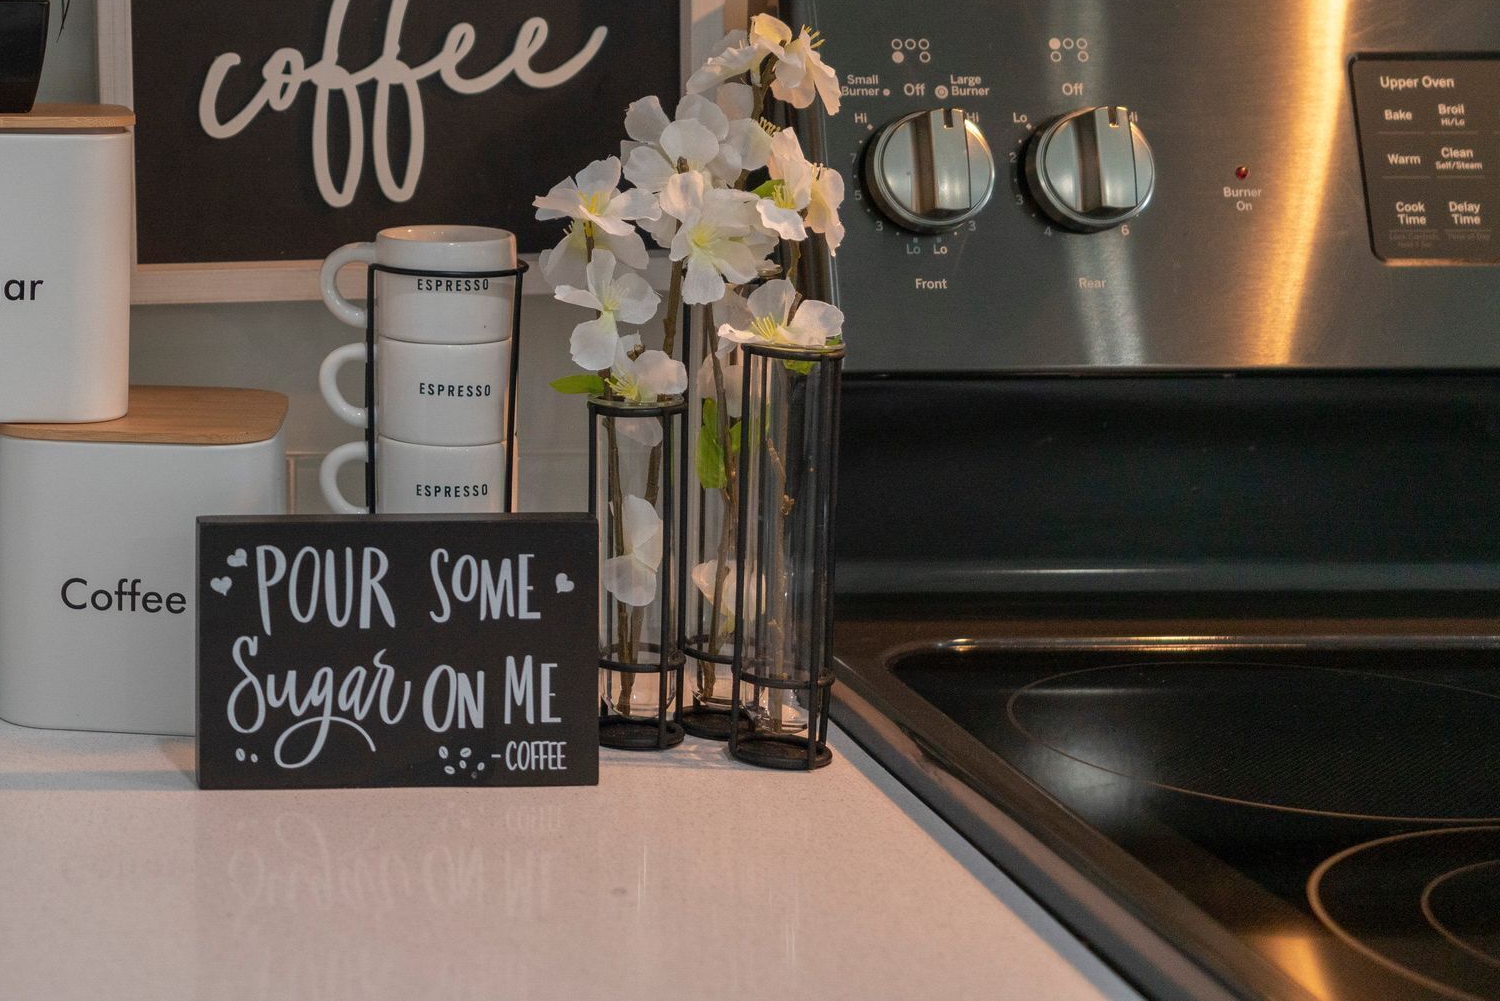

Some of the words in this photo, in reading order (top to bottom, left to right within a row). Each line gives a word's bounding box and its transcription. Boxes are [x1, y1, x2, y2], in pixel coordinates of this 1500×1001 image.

[847, 74, 879, 85] Small
[950, 74, 982, 86] Large
[1380, 76, 1419, 90] Upper
[1421, 75, 1455, 89] Oven
[841, 86, 880, 96] Burner
[903, 83, 926, 96] Off
[951, 86, 990, 96] Burner
[1062, 82, 1085, 96] Off
[1384, 109, 1413, 121] Bake
[1438, 103, 1465, 115] Broil
[854, 112, 868, 124] Hi
[1012, 111, 1028, 124] Lo
[1441, 117, 1466, 127] Hi/Lo
[1009, 152, 1018, 164] 2
[1387, 153, 1421, 165] Warm
[1441, 147, 1474, 159] Clean
[1435, 160, 1483, 170] Self/Steam
[854, 189, 862, 201] 5
[1222, 186, 1263, 198] Burner
[1015, 194, 1024, 206] 3
[1236, 200, 1253, 212] On
[1395, 201, 1426, 213] Cook
[1448, 201, 1481, 214] Delay
[1397, 213, 1427, 225] Time
[1451, 213, 1481, 225] Time
[875, 220, 884, 232] 3
[968, 220, 977, 232] 3
[1121, 225, 1130, 236] 6
[906, 243, 921, 255] Lo
[933, 243, 948, 255] Lo
[417, 278, 489, 292] ESPRESSO
[915, 278, 948, 290] Front
[1078, 277, 1107, 289] Rear
[419, 382, 491, 397] ESPRESSO
[416, 483, 489, 498] ESPRESSO
[60, 577, 188, 614] Coffee
[255, 544, 396, 636] POUR
[429, 548, 542, 624] SOME
[227, 635, 411, 769] Sugar
[423, 664, 485, 733] ON
[504, 654, 562, 725] ME
